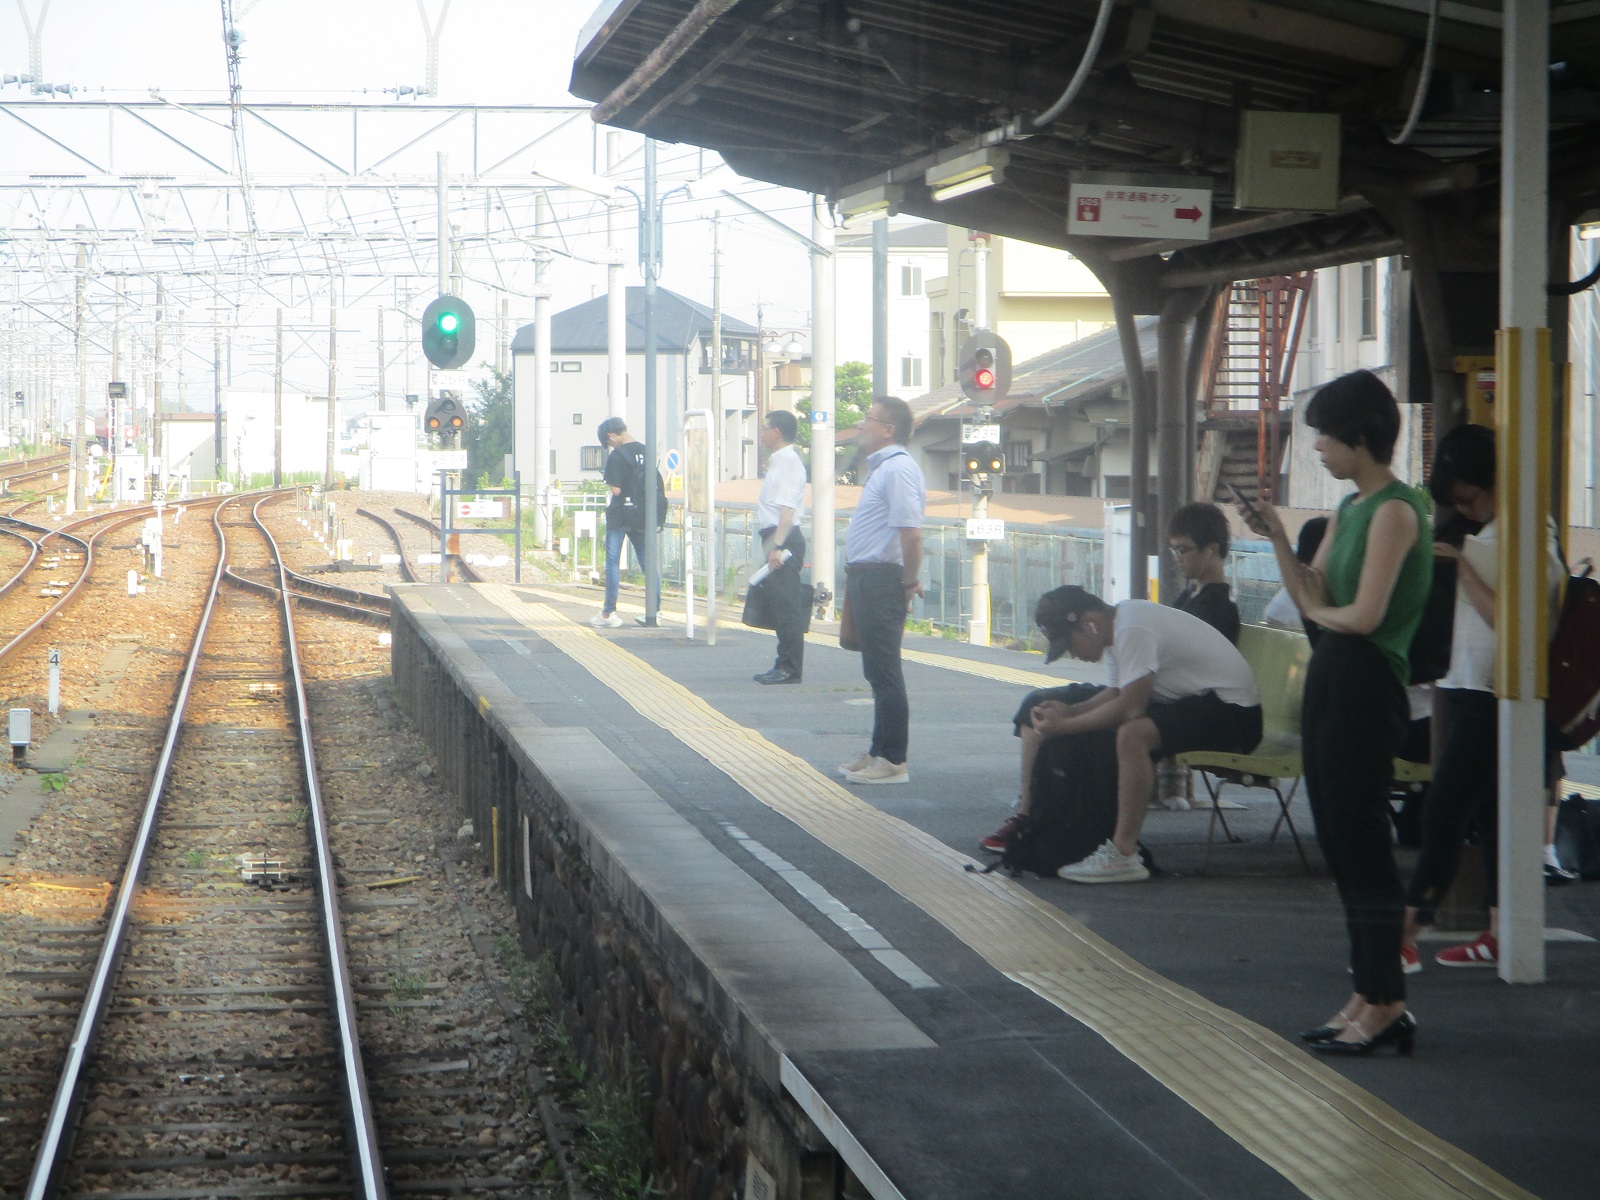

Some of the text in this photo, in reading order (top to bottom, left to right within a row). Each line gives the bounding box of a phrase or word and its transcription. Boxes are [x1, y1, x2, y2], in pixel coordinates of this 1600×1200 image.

[1078, 198, 1099, 206] SOS
[153, 490, 166, 500] 35
[976, 524, 1002, 535] 63R
[50, 654, 59, 666] 4
